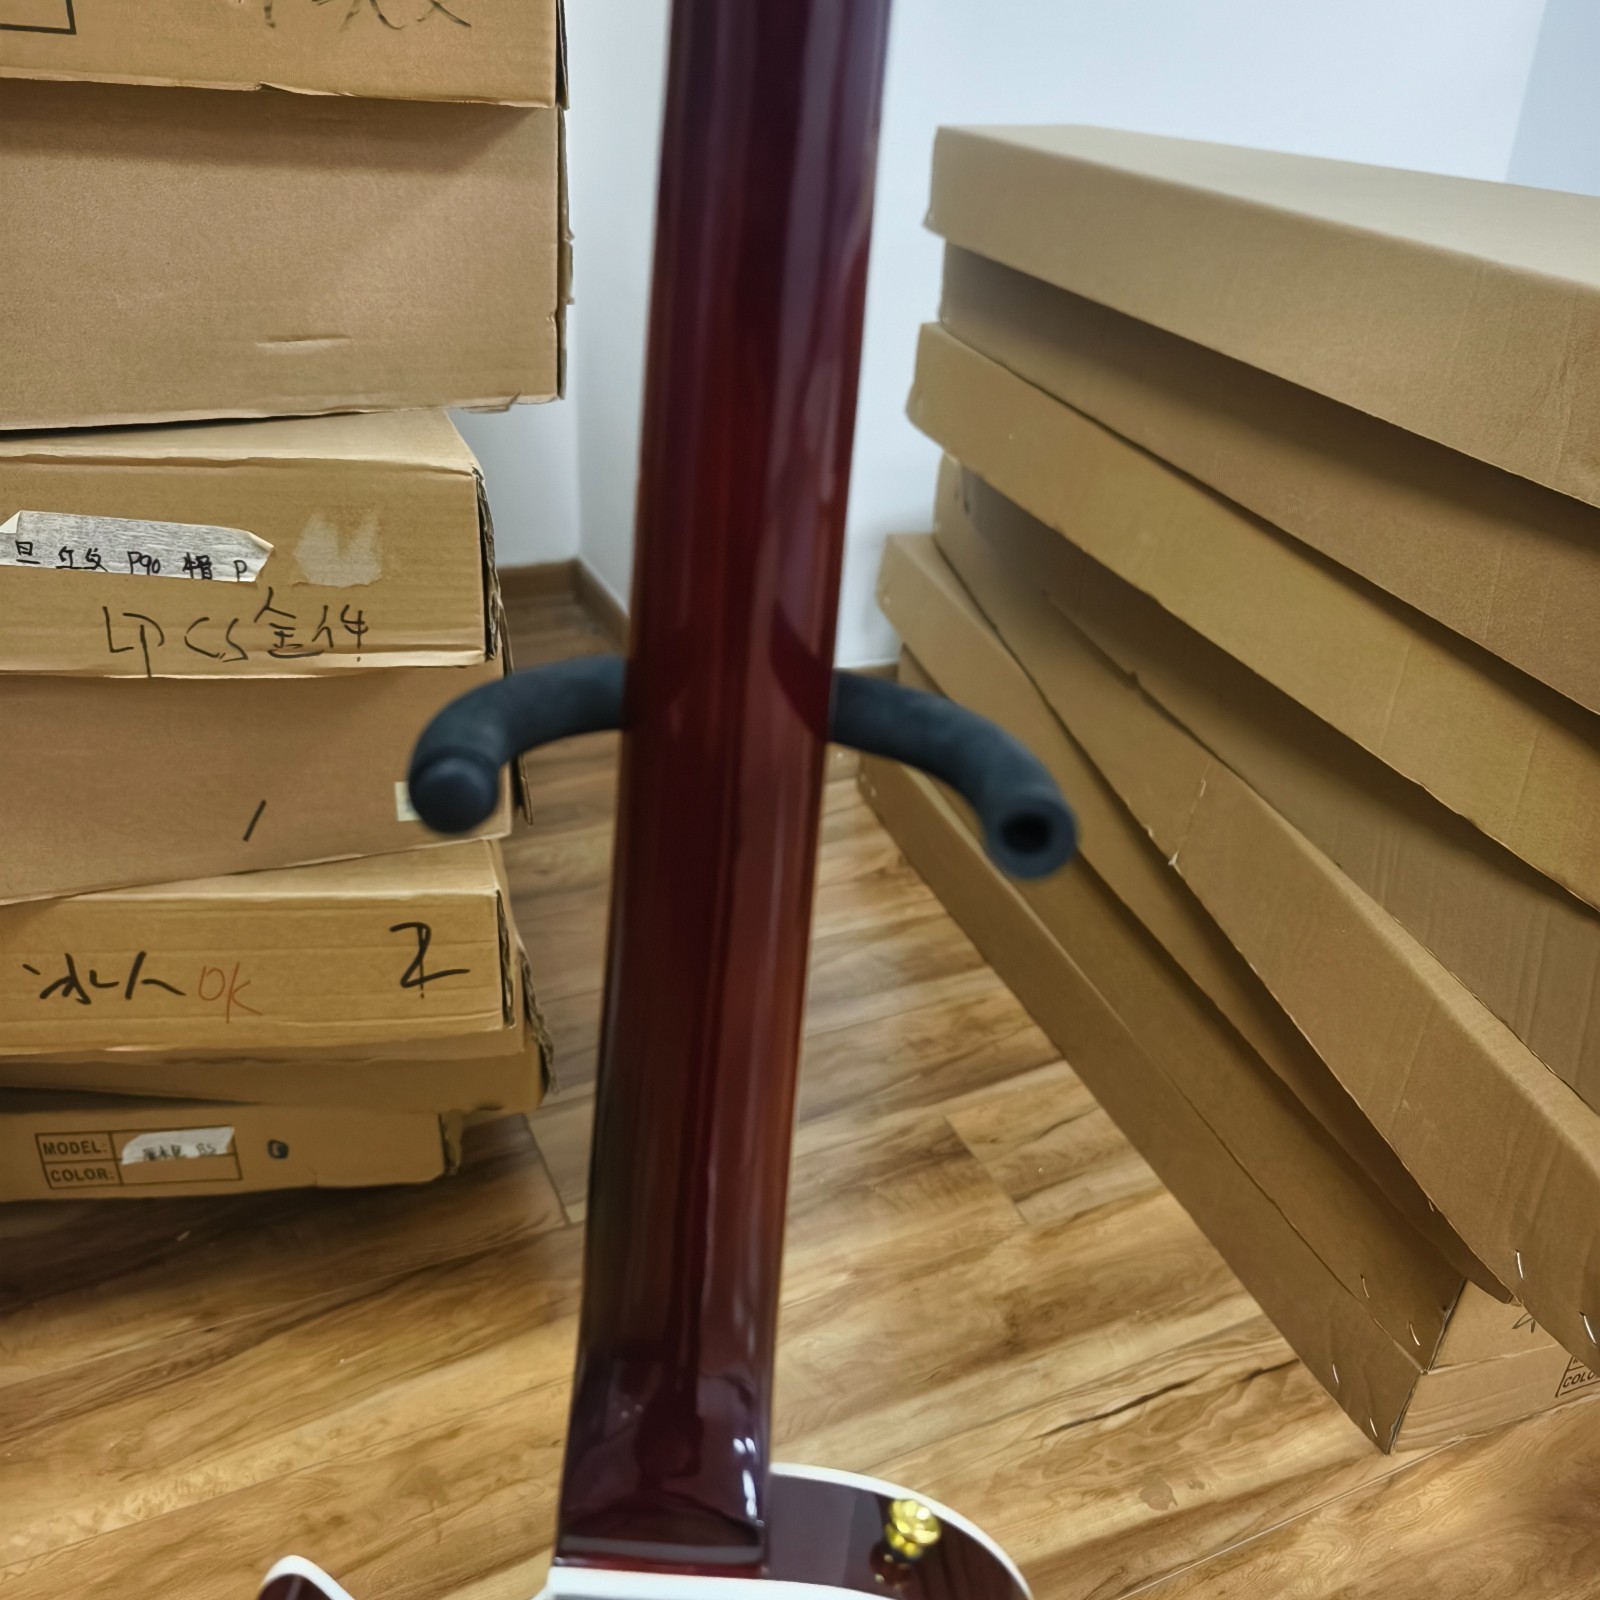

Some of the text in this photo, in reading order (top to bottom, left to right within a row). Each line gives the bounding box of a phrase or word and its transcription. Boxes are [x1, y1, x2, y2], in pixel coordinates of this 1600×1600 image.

[126, 550, 162, 576] P90
[198, 961, 263, 1024] OK
[1562, 1370, 1595, 1388] COLO
